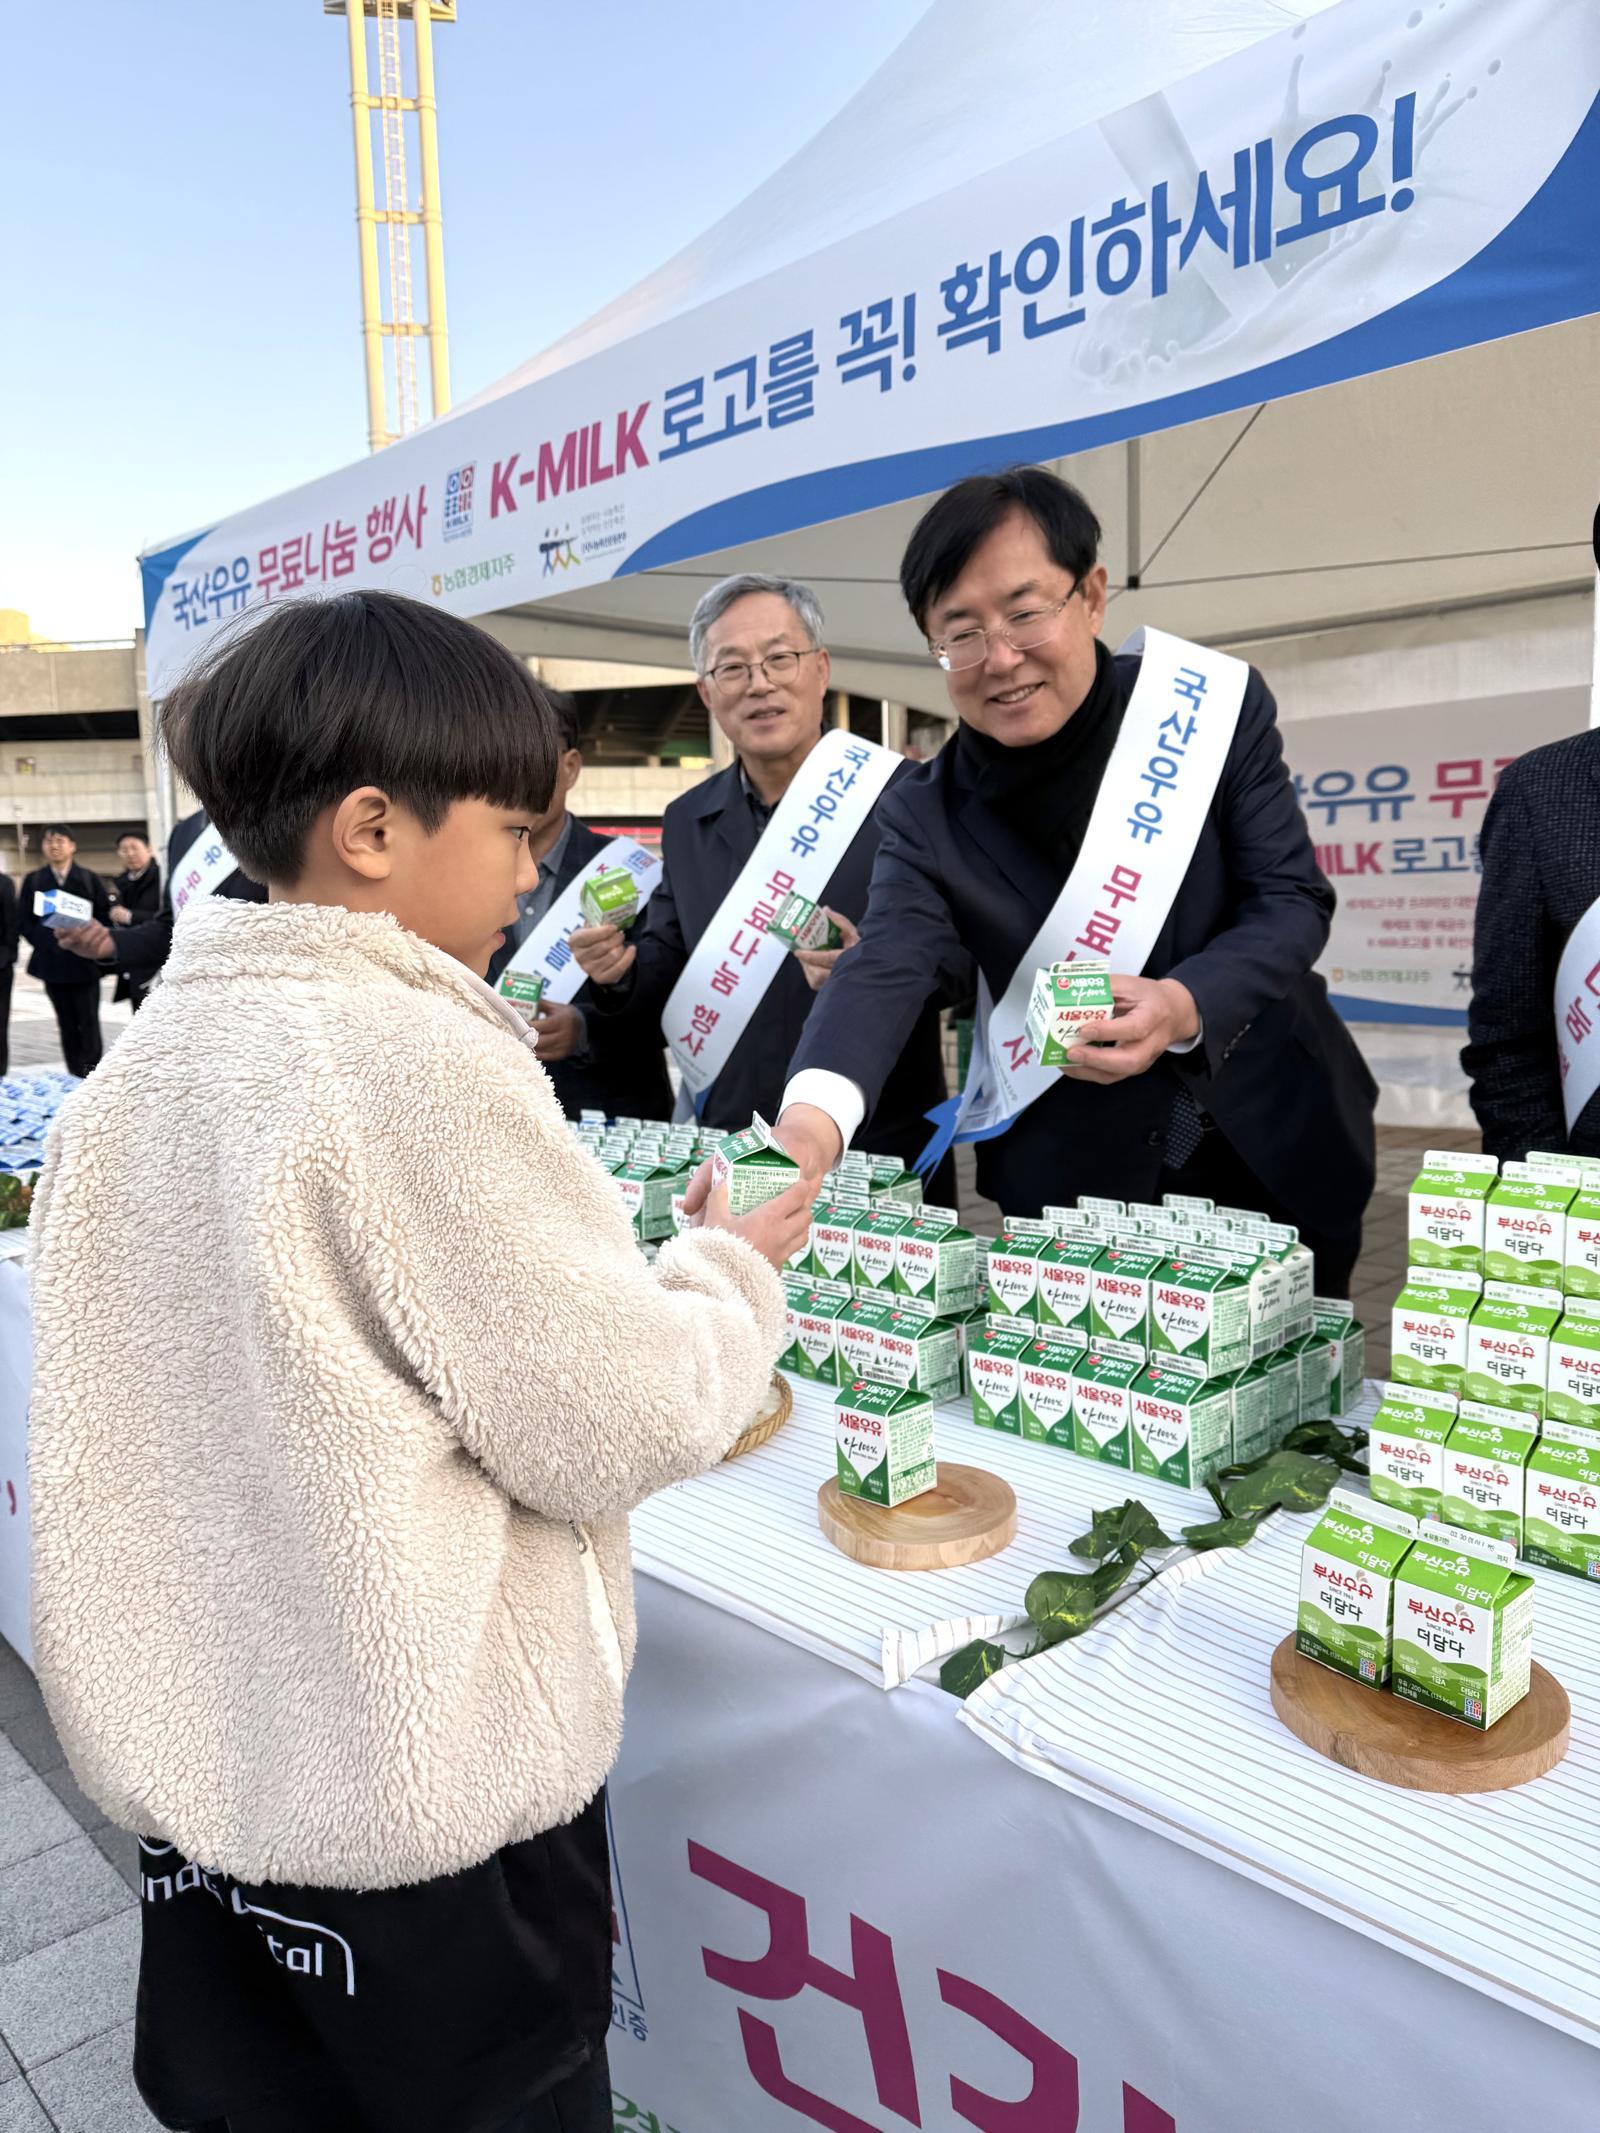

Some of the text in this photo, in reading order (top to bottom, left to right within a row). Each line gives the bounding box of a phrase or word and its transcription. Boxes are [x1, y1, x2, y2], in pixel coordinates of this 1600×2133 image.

[172, 90, 1418, 631] 국산우유 무료나눔 행사 K-MILK 로고를 꼭! 확인하세요!
[444, 552, 516, 593] 농협경제지주
[1126, 666, 1208, 845] 국산우유
[789, 744, 872, 859] 국산우유
[1294, 763, 1416, 826] 우유
[1064, 863, 1143, 962] 무료
[710, 869, 796, 998] 무료나눔
[1057, 1009, 1107, 1021] 서울우유
[679, 1004, 721, 1058] 행사
[1001, 1033, 1034, 1073] 사
[1419, 1204, 1472, 1222] 부산우유
[816, 1228, 848, 1244] 서울우유
[1427, 1226, 1465, 1242] 더담다
[1497, 1217, 1553, 1235] 부산우유
[858, 1235, 891, 1252] 서울우유
[899, 1241, 933, 1260] 서울우유
[1504, 1238, 1544, 1256] 더담다
[1096, 1277, 1142, 1298] 서울우유
[1157, 1288, 1206, 1312] 서울우유
[1402, 1320, 1456, 1340] 부산우유
[1410, 1341, 1448, 1360] 더담다
[1479, 1337, 1535, 1360] 부산우유
[1487, 1360, 1527, 1379] 더담다
[1076, 1384, 1124, 1408] 서울우유
[1135, 1399, 1184, 1425] 서울우유
[838, 1412, 882, 1437] 서울우유
[1380, 1442, 1432, 1465] 부산우유
[1387, 1463, 1425, 1484] 더담다
[1454, 1462, 1511, 1487] 부산우유
[1462, 1484, 1503, 1507] 더담다
[1537, 1482, 1598, 1511] 부산우유
[1545, 1506, 1589, 1530] 더담다
[1321, 1518, 1375, 1545] 부산우유
[1357, 1550, 1392, 1573] 더담다
[1412, 1551, 1471, 1577] 부산우유
[1313, 1562, 1374, 1600] 부산우유
[1454, 1583, 1493, 1604] 더담다
[1320, 1590, 1364, 1622] 더담다
[1407, 1598, 1476, 1635] 부산우유
[1426, 1622, 1442, 1632] SINCE
[1416, 1627, 1465, 1659] 더담다
[1460, 1686, 1480, 1699] 더담다
